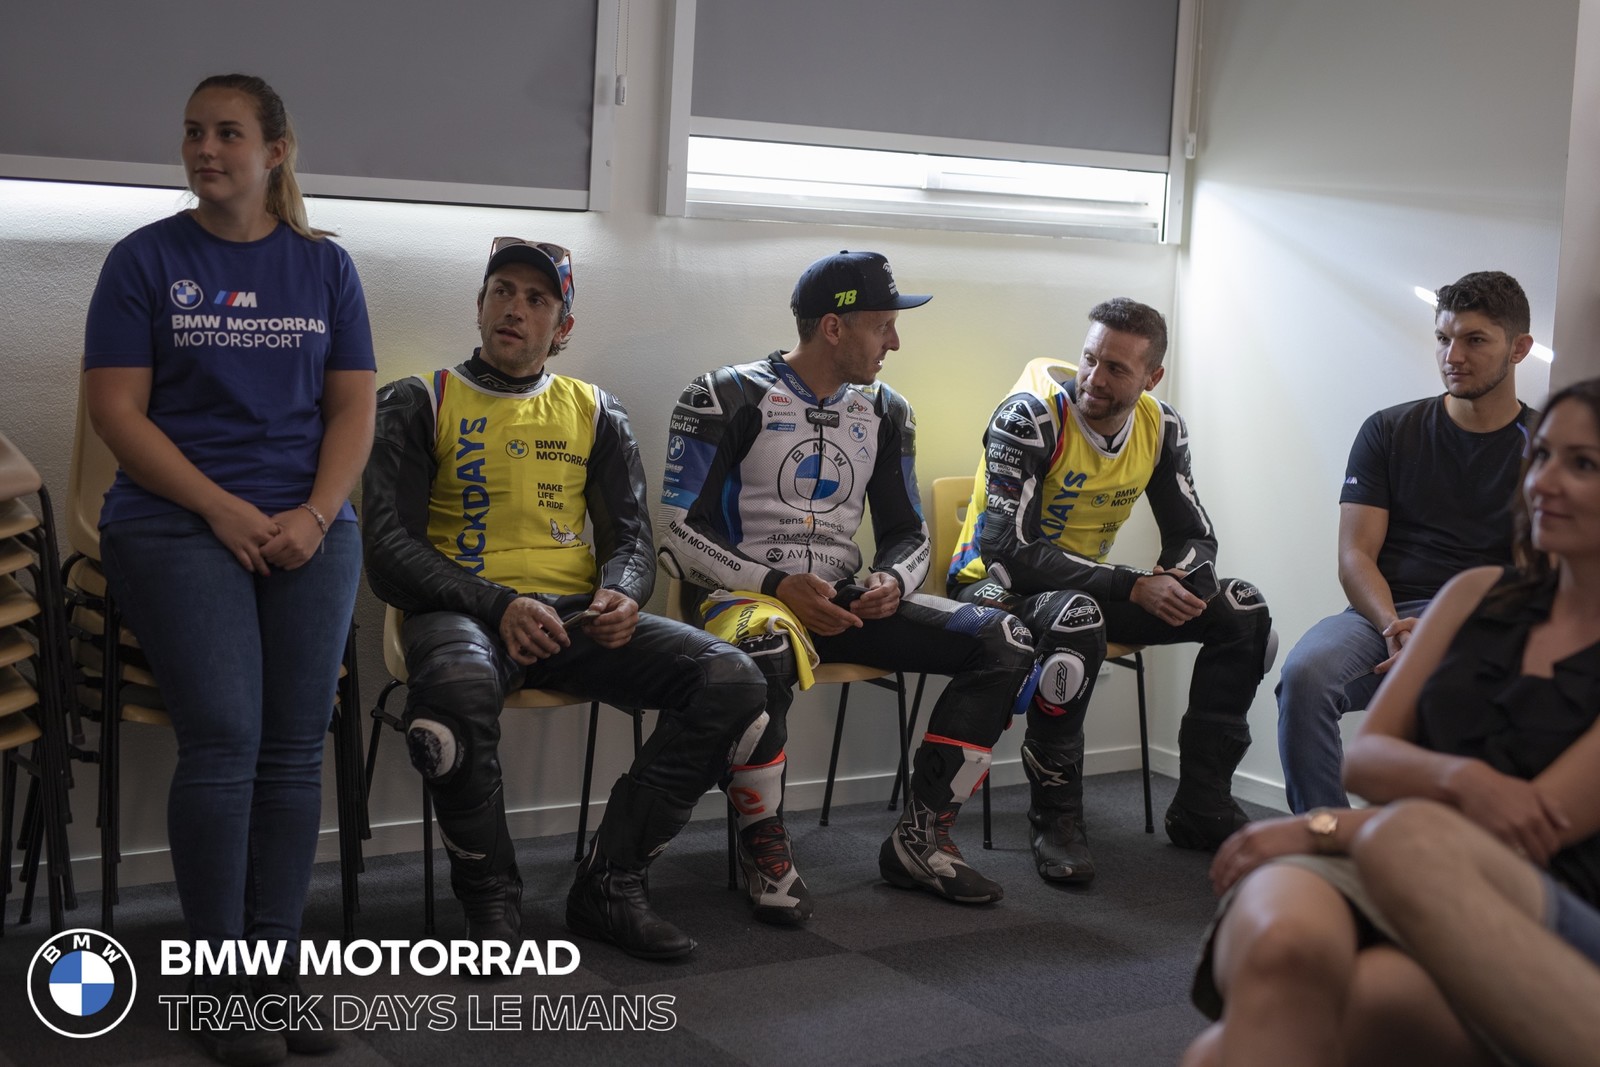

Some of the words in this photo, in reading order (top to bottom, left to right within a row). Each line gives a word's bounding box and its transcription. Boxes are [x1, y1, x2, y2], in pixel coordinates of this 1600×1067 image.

[835, 290, 857, 307] 78
[172, 315, 221, 329] BMW
[227, 317, 325, 334] MOTORRAD
[174, 331, 303, 348] MOTORSPORT
[683, 415, 699, 423] WITH
[809, 411, 838, 420] RST
[535, 440, 567, 449] BMW
[1005, 446, 1023, 456] WITH
[791, 442, 846, 467] BMW
[537, 483, 563, 492] MAKE
[1115, 487, 1138, 498] BMW
[537, 491, 554, 500] LIFE
[546, 501, 564, 510] RIDE
[669, 521, 688, 540] BMW
[687, 536, 742, 572] MOTORRAD
[787, 549, 846, 570] AVANISTA
[1062, 606, 1098, 622] RST
[1055, 661, 1067, 702] RST
